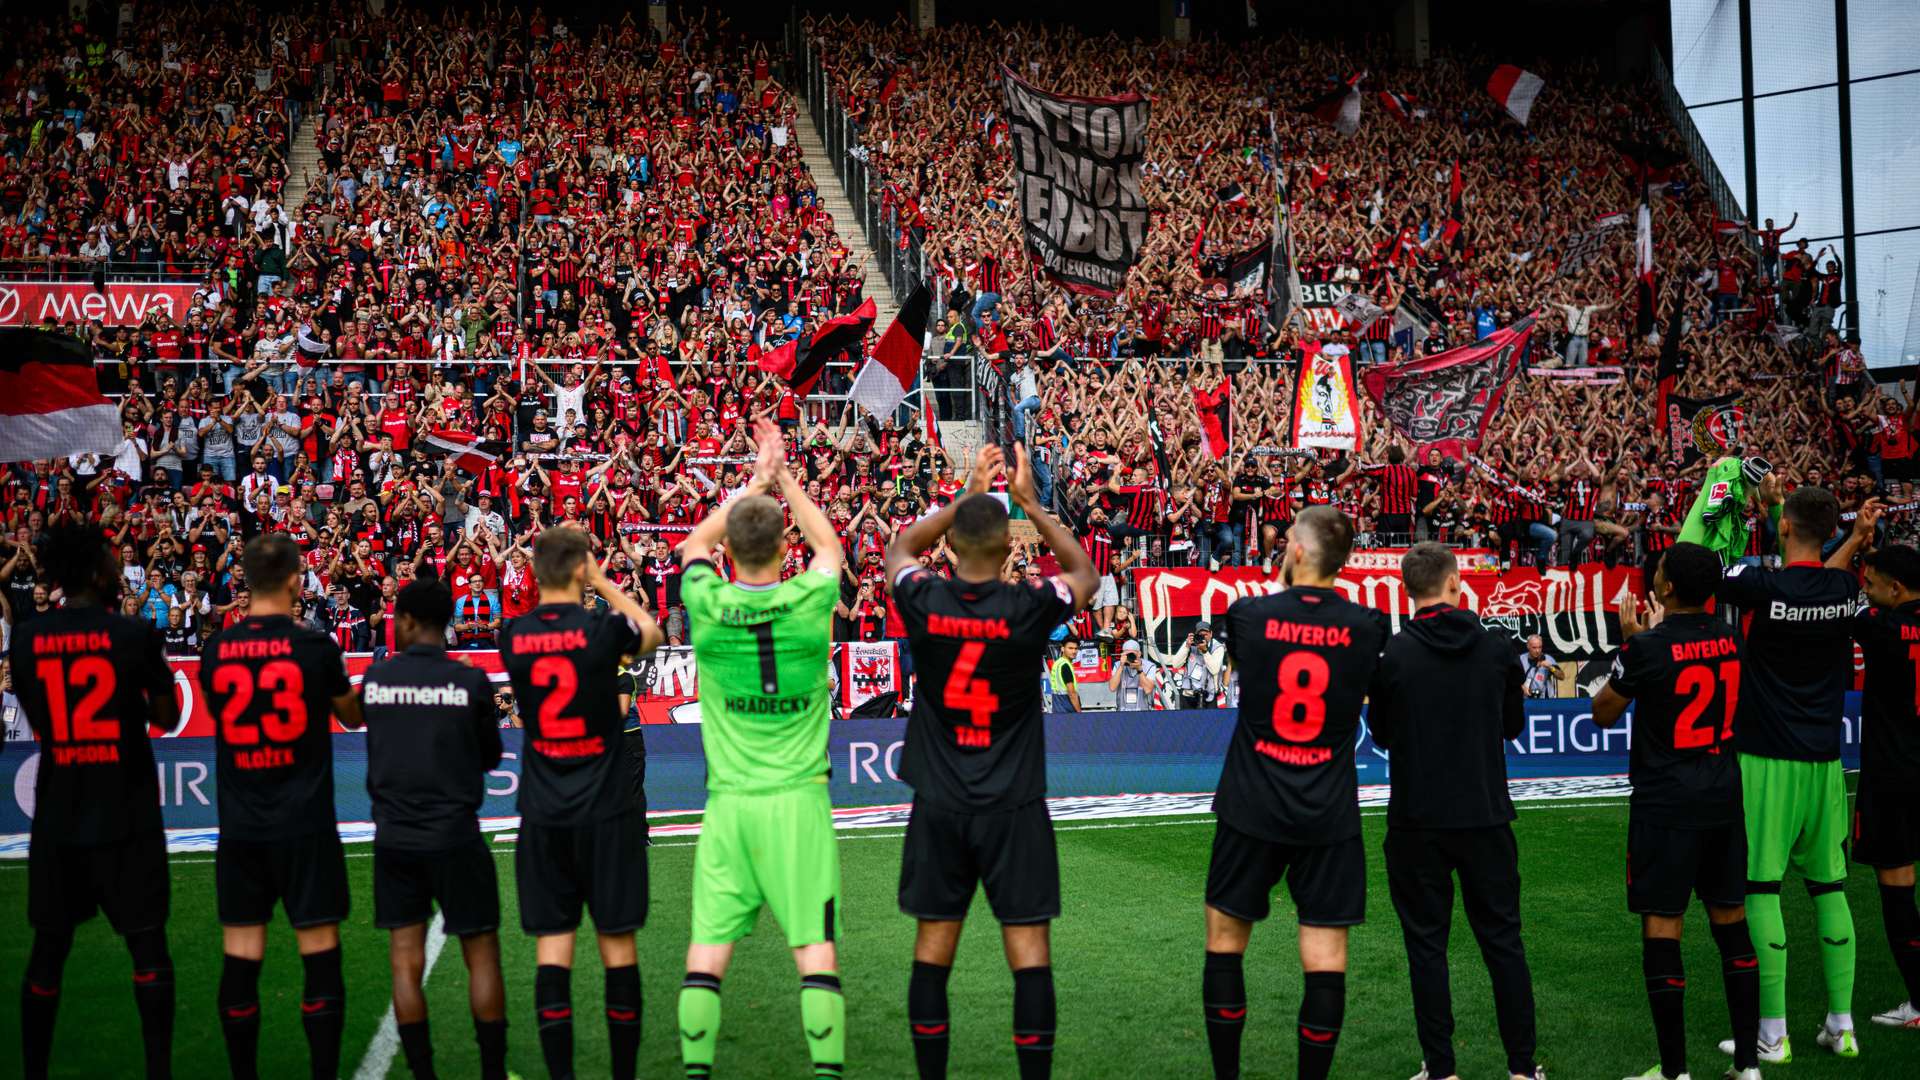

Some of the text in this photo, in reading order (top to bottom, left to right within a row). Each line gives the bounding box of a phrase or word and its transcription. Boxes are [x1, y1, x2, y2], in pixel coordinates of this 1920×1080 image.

[38, 292, 174, 321] mewa
[1769, 598, 1856, 622] Barmenia
[36, 655, 120, 742] 12
[364, 681, 469, 707] Barmenia
[530, 654, 586, 739] 2
[747, 621, 779, 695] 1
[943, 640, 999, 728] 4
[1272, 650, 1330, 743] 8
[212, 660, 308, 745] 23
[1673, 660, 1741, 750] 21
